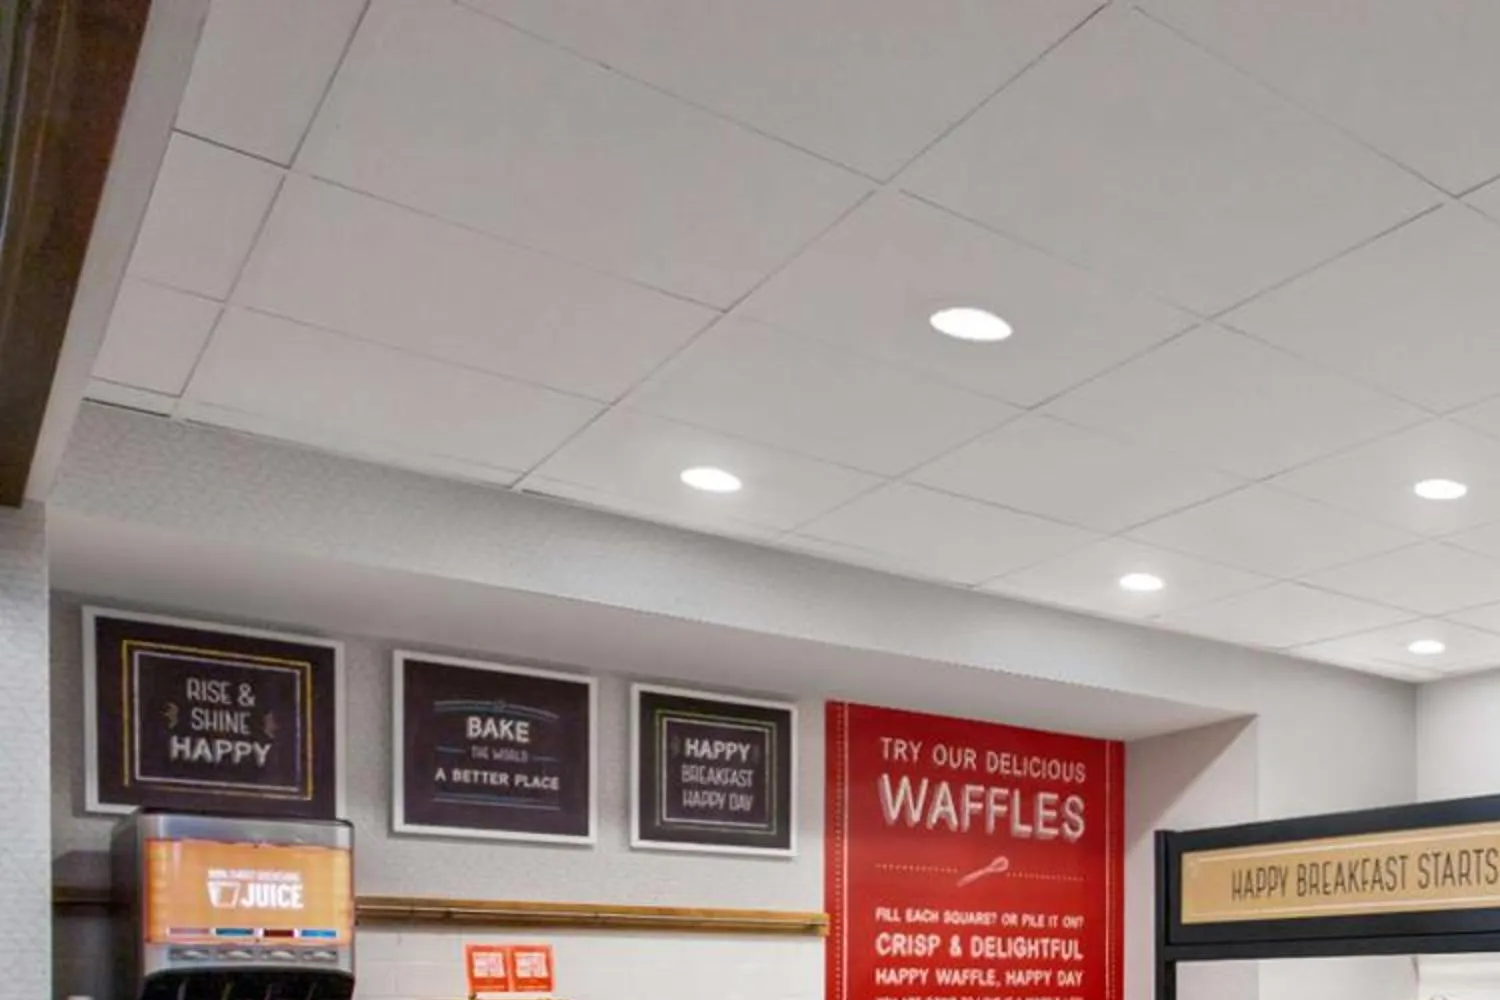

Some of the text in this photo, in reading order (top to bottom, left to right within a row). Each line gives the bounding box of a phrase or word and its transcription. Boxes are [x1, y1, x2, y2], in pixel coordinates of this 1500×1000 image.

[186, 677, 256, 707] RISE &
[191, 706, 250, 735] SHINE
[466, 716, 530, 743] BAKE
[169, 734, 272, 767] HAPPY
[685, 738, 751, 763] HAPPY
[880, 737, 1086, 784] TRY OUR DELICIOUS
[435, 768, 559, 791] A BETTER PLACE
[682, 764, 753, 788] BREAKFAST
[682, 789, 753, 811] HAPPY DAY
[878, 773, 1086, 843] WAFFLES
[1231, 865, 1288, 901] HAPPY
[1296, 854, 1408, 898] BREAKFAST
[1418, 847, 1499, 890] STARTS
[240, 883, 304, 910] JUICE
[875, 906, 900, 922] FILL
[905, 908, 939, 924] EACH
[1001, 912, 1018, 926] OR
[1021, 913, 1045, 928] PILE
[1048, 915, 1058, 929] IT
[875, 932, 1084, 960] CRISP & DELIGHTFUL
[875, 967, 1083, 989] HAPPY WAFFLE, HAPPY DAY
